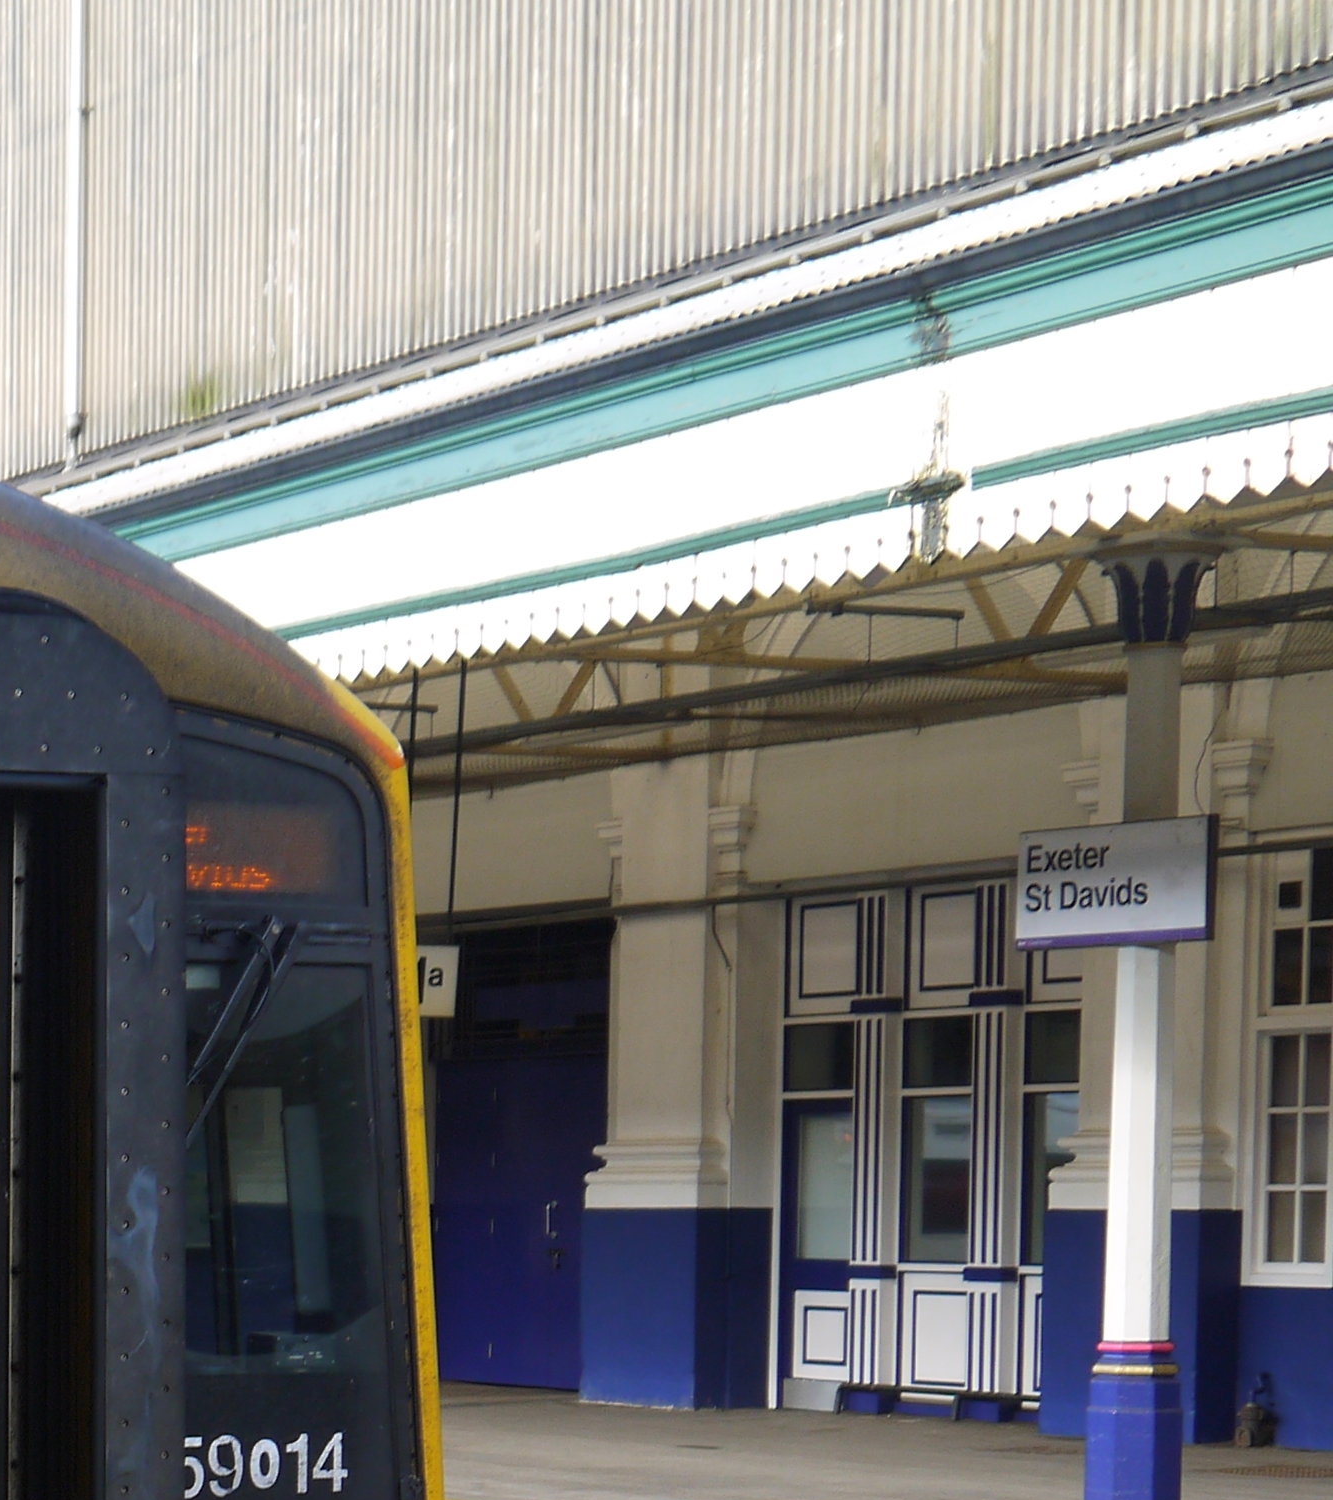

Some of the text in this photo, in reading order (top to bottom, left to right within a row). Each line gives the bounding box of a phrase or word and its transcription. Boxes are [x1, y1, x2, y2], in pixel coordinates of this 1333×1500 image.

[1026, 843, 1110, 874] Exeter
[1026, 876, 1149, 912] St Davids
[184, 1432, 349, 1499] 59014
